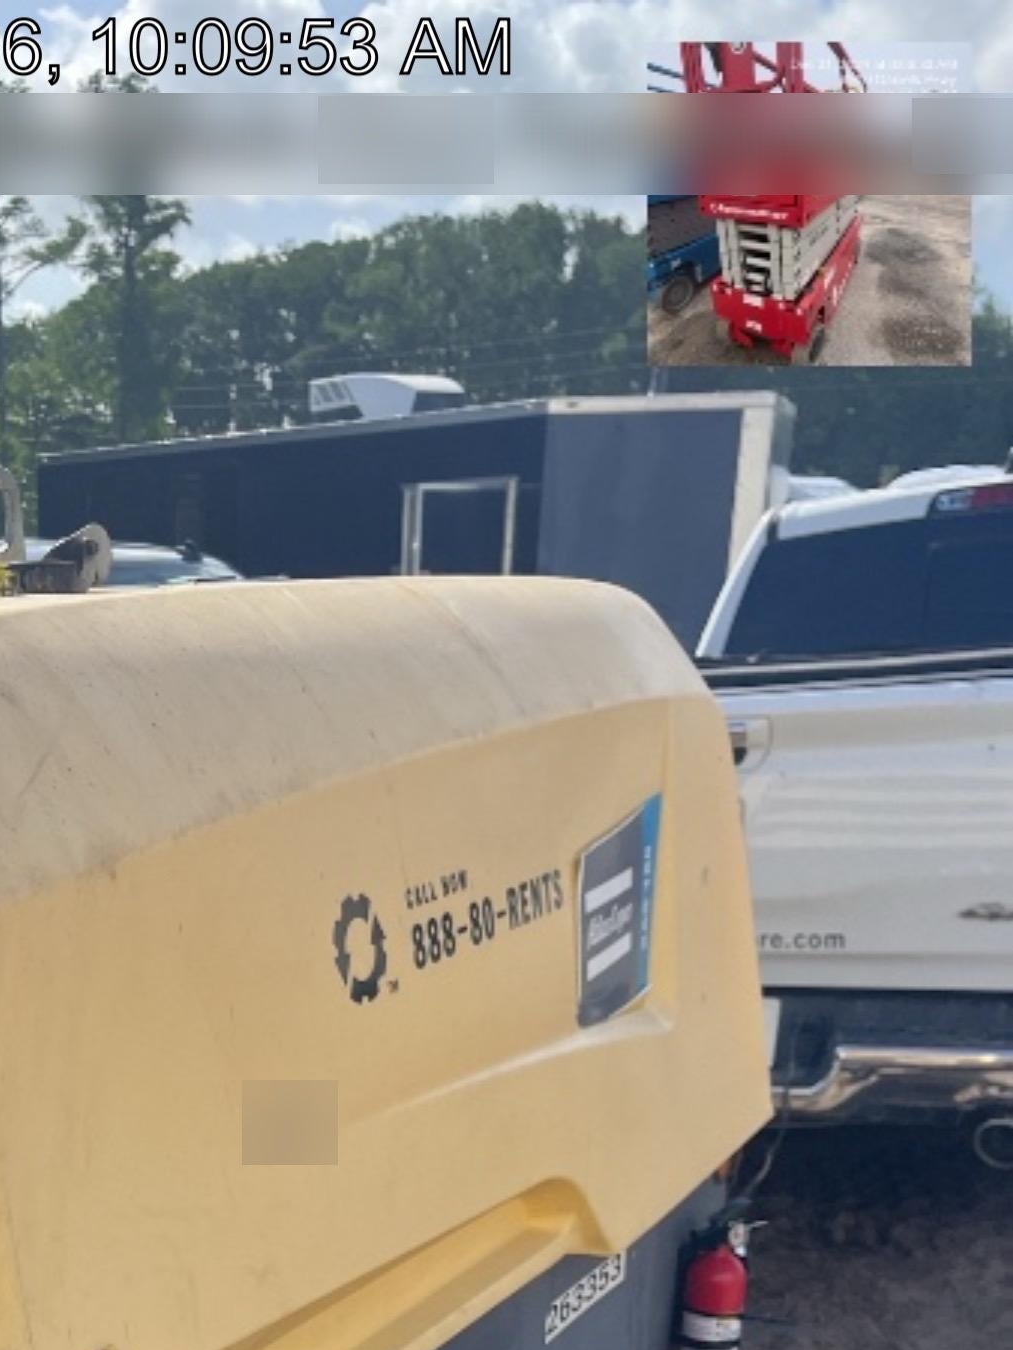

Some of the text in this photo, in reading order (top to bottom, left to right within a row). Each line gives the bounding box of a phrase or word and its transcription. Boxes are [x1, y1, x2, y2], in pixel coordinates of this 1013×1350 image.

[405, 869, 468, 910] CALL NOW
[412, 869, 564, 970] 888-80-RENTS
